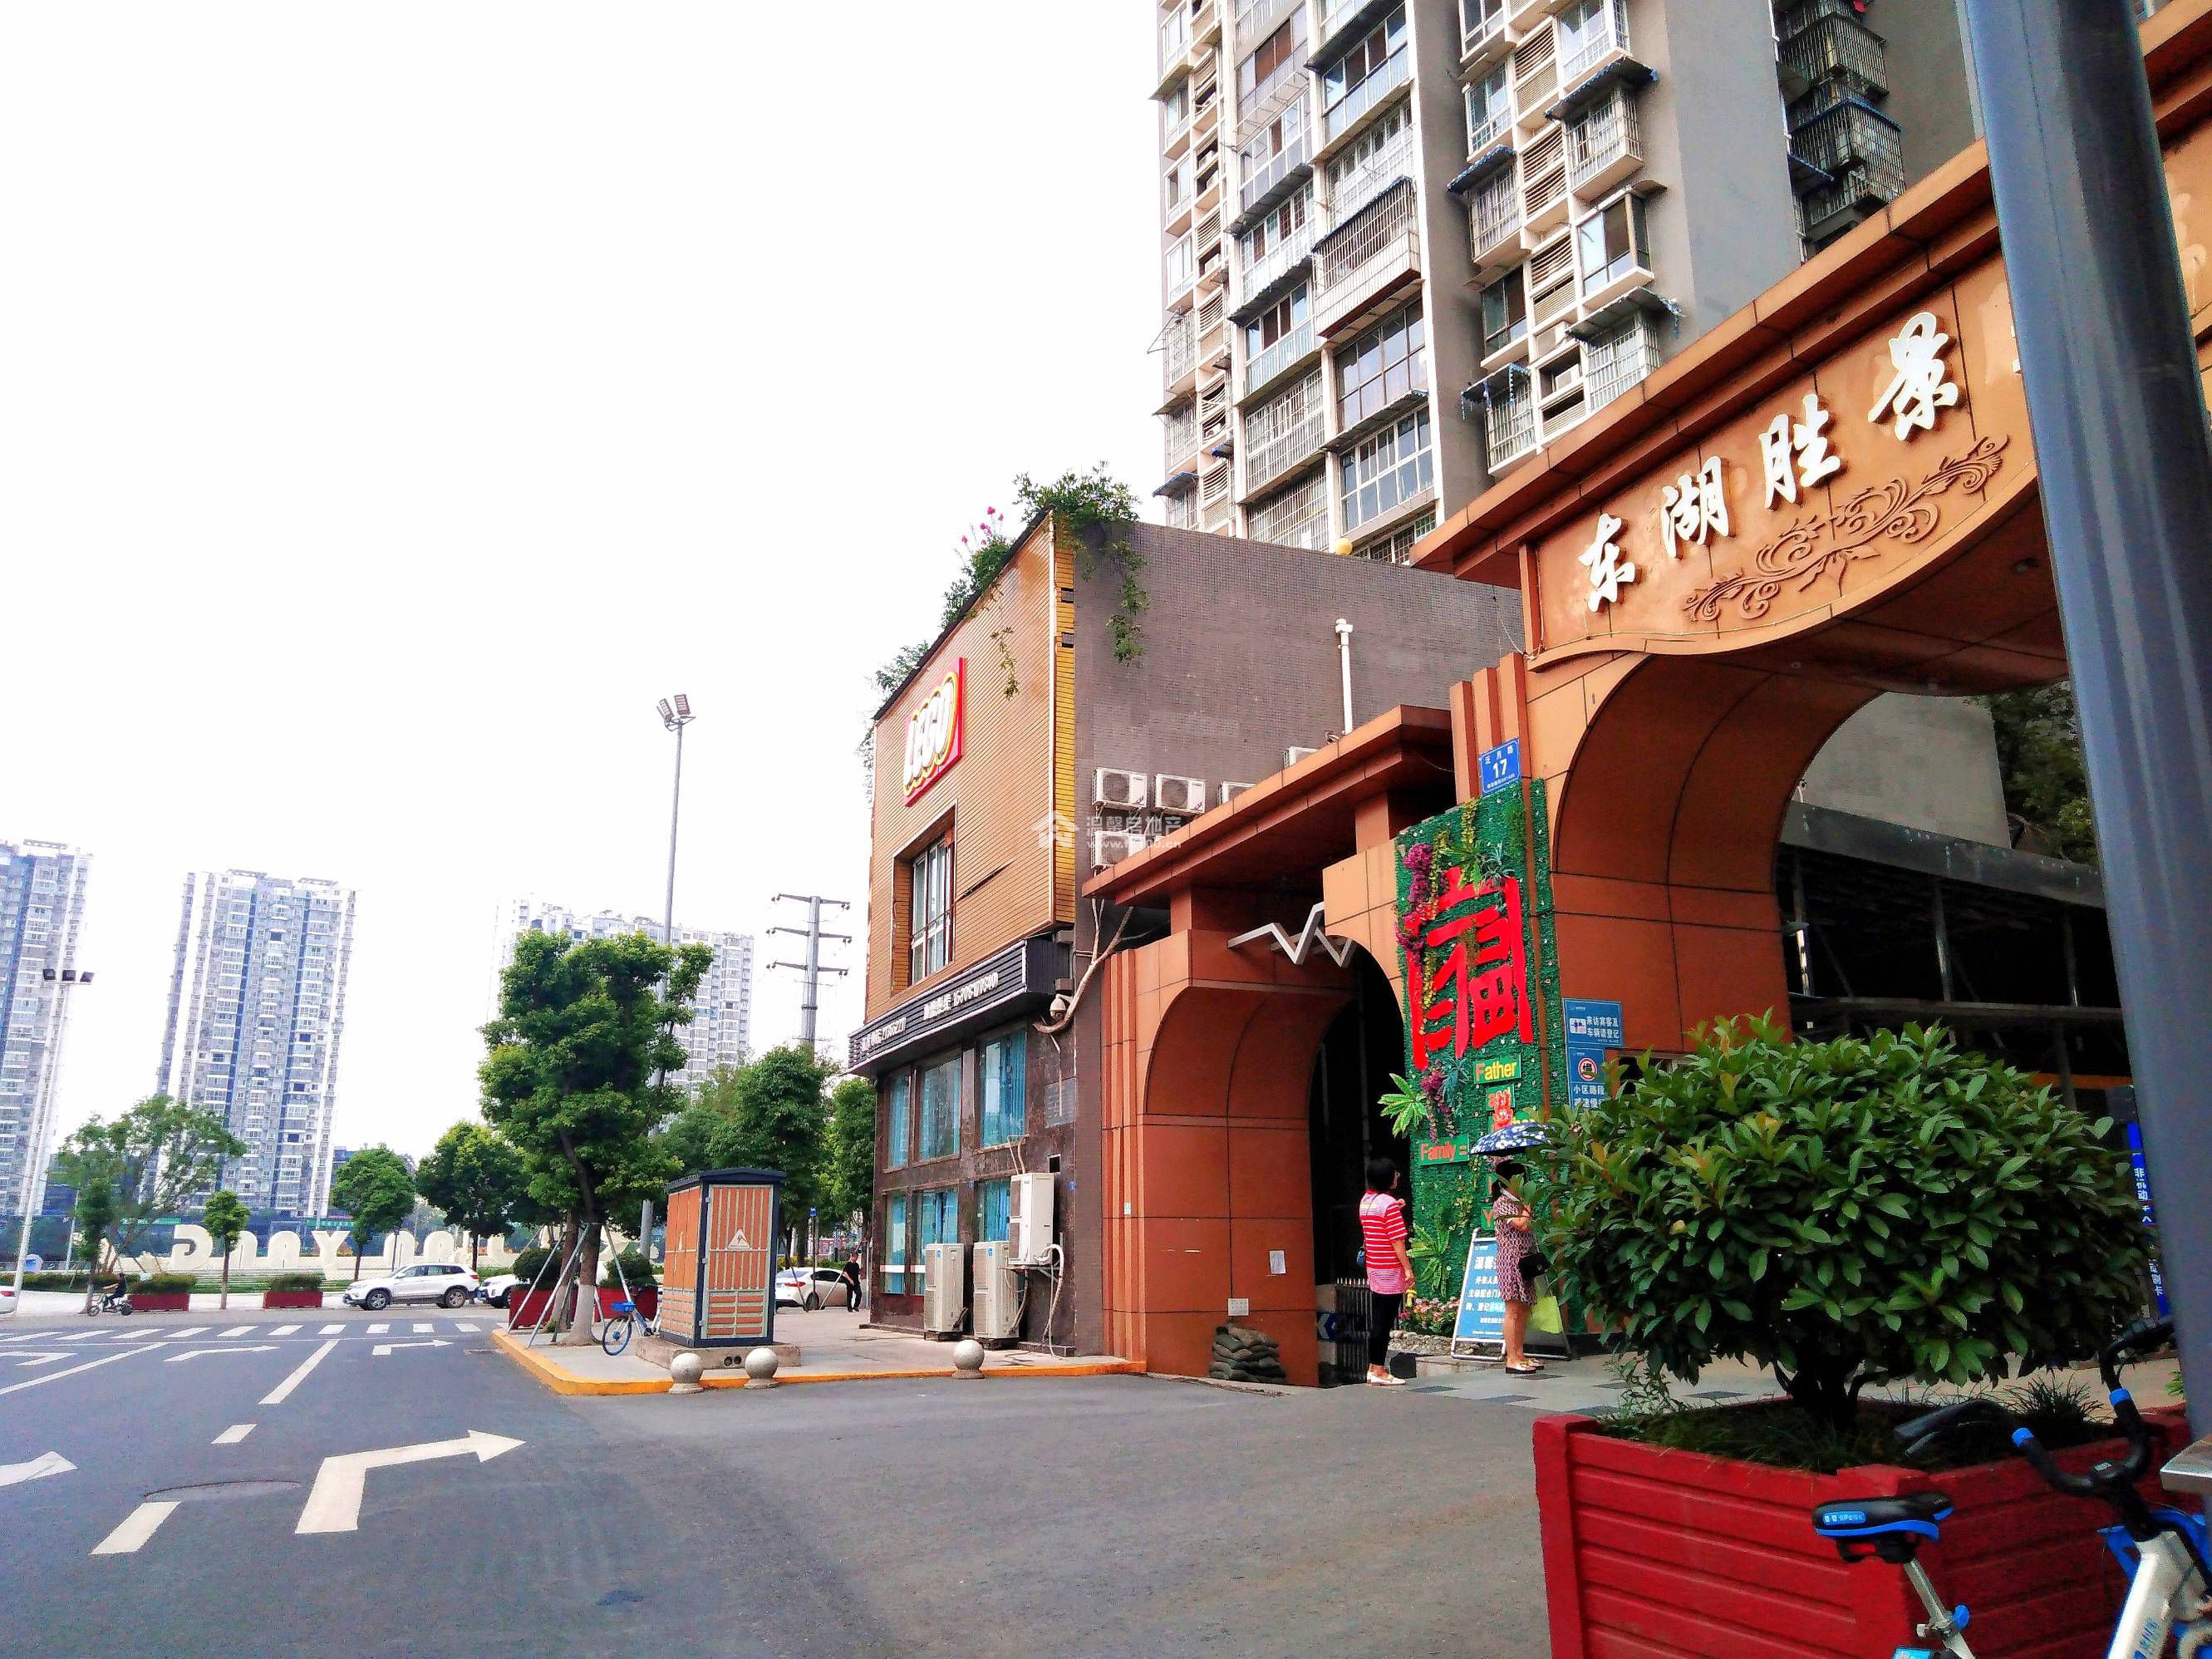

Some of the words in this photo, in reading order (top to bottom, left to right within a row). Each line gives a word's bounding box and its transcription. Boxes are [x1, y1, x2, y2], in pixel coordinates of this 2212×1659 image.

[1579, 312, 1959, 612] 东湖胜景
[1492, 757, 1508, 779] 17
[1475, 1061, 1516, 1081] Father
[1420, 1141, 1456, 1161] Family
[1473, 1256, 1497, 1270] 温馨
